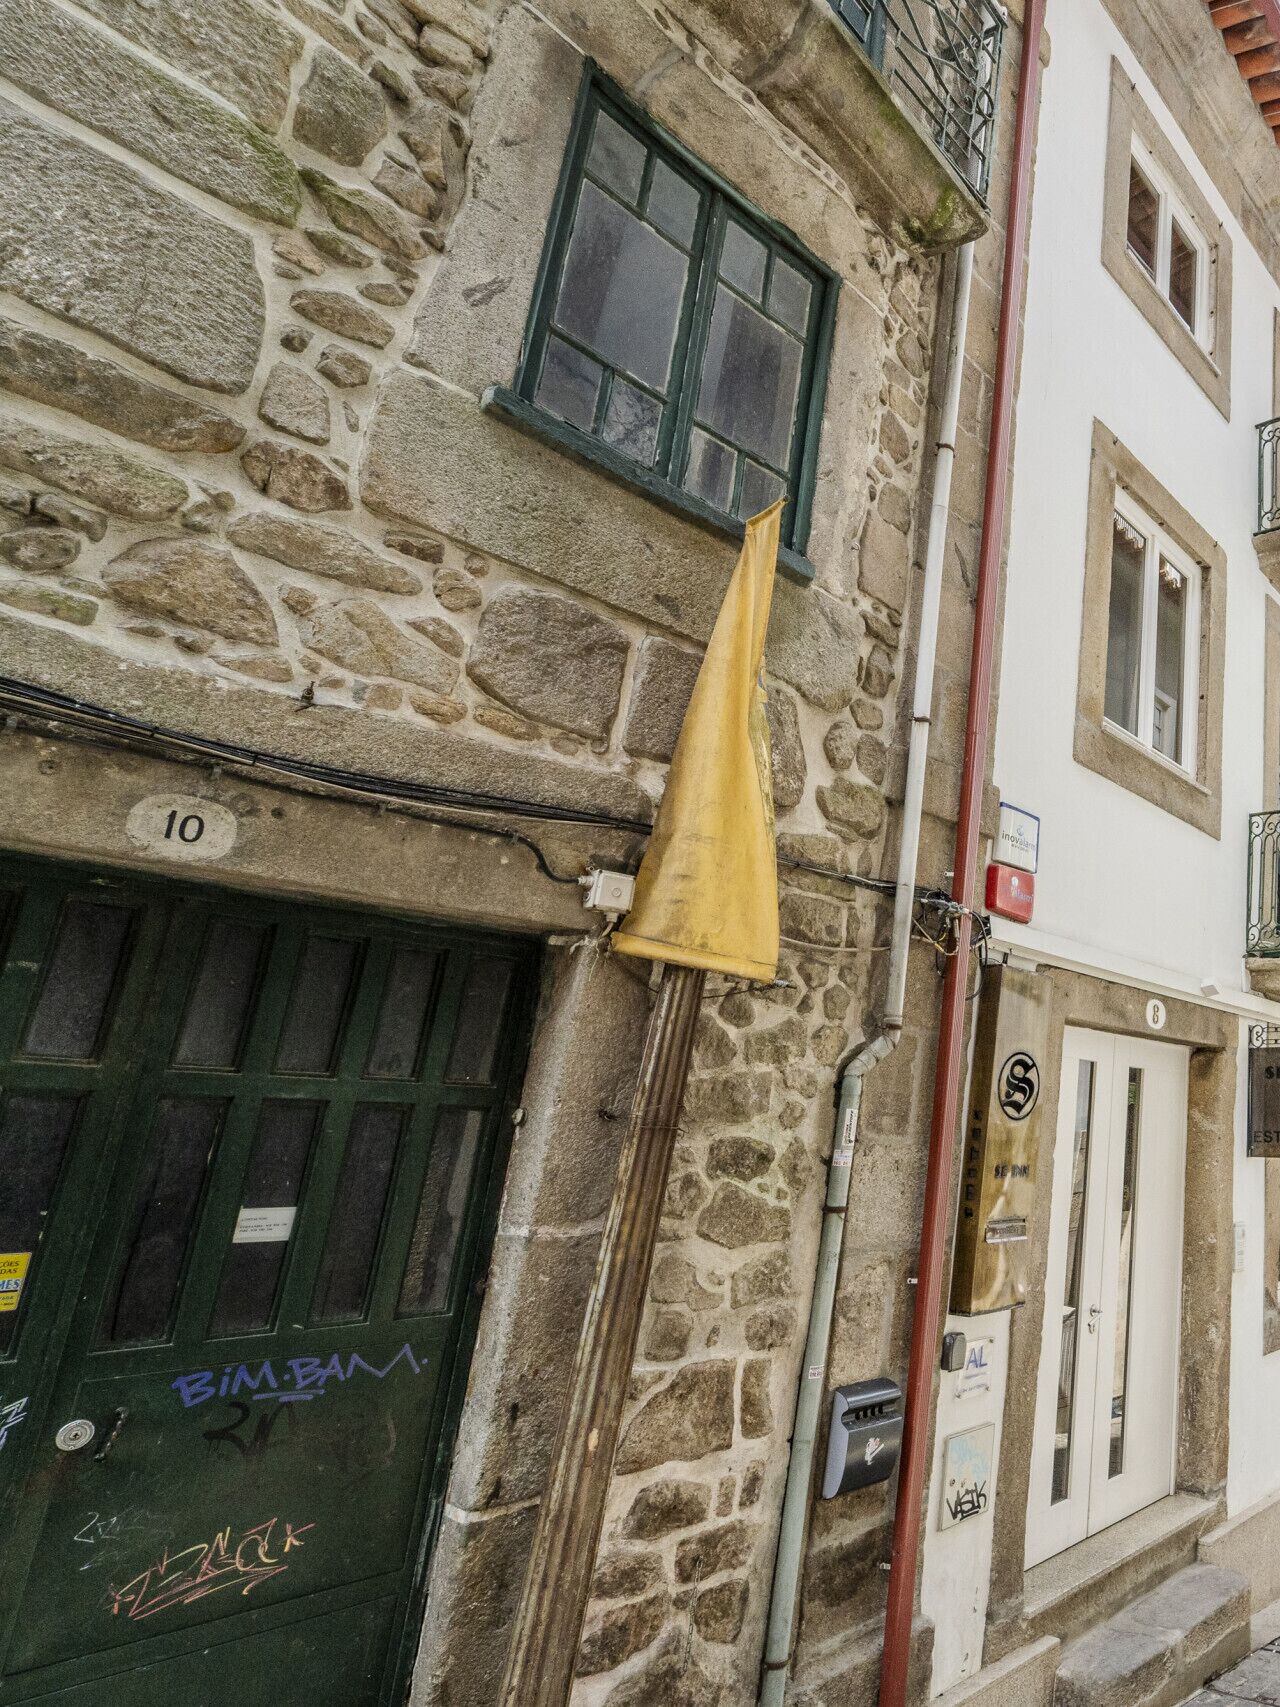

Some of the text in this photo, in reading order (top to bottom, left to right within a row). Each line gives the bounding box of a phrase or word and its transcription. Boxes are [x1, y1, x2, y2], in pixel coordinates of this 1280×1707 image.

[164, 809, 205, 843] 10
[1152, 1004, 1160, 1025] 8
[966, 1346, 988, 1371] AL
